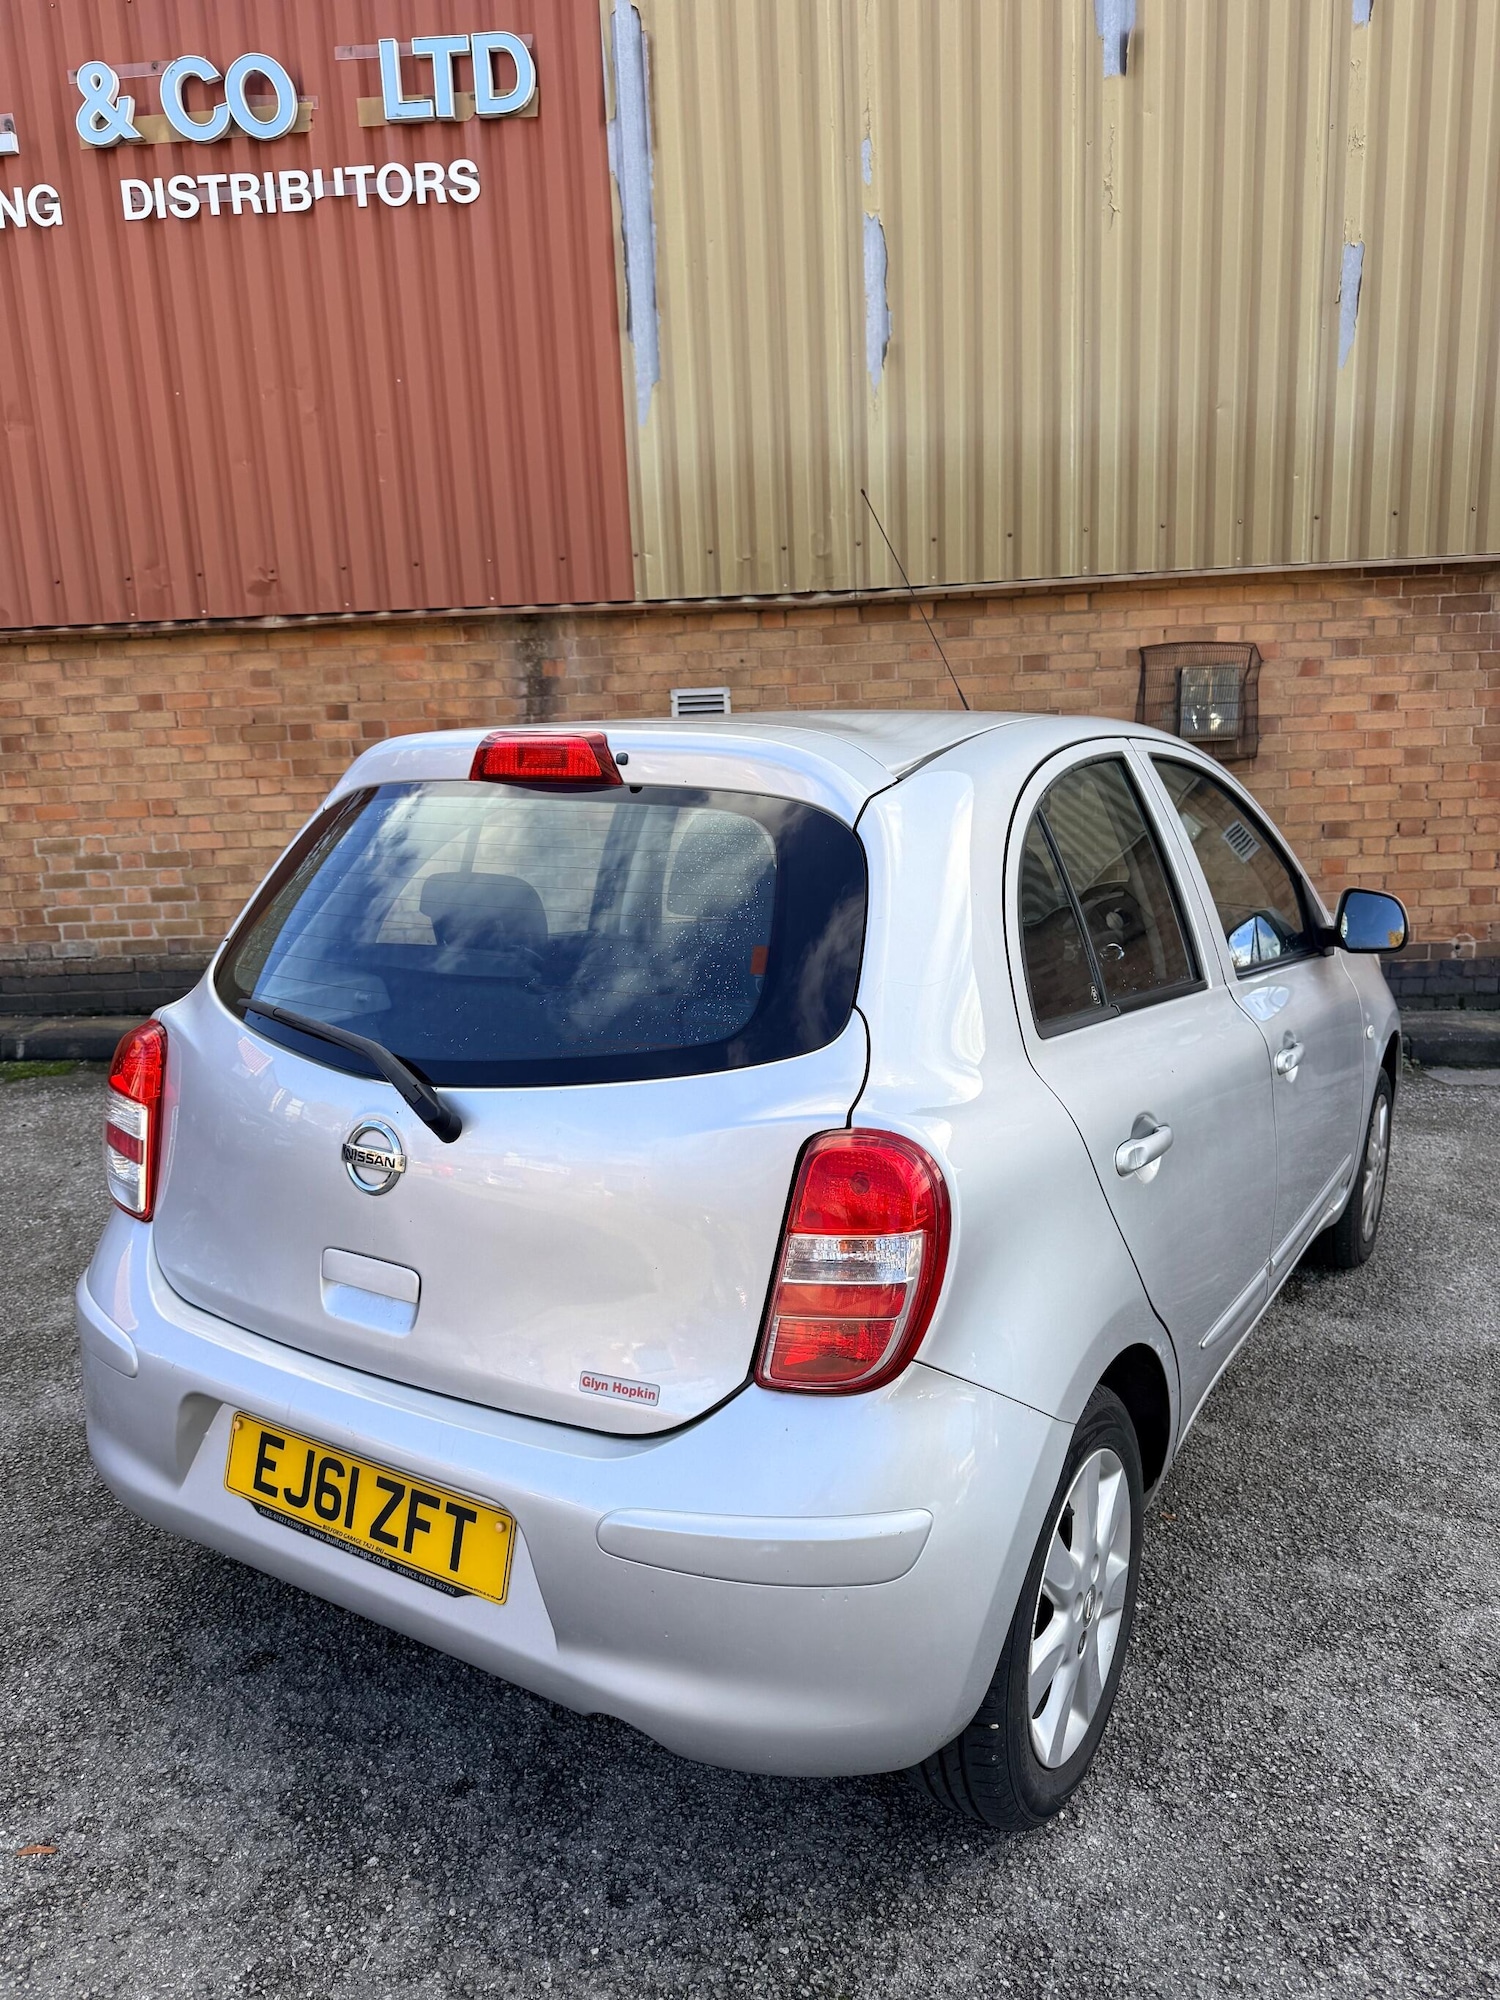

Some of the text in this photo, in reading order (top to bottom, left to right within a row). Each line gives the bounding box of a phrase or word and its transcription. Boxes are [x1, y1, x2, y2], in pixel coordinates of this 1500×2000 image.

[75, 60, 143, 146] &
[160, 52, 298, 145] CO
[378, 31, 536, 123] LTD
[343, 1145, 395, 1168] NISSAN
[582, 1376, 656, 1400] Glyn Hopkin
[253, 1431, 477, 1572] EJ61 ZFT
[309, 1527, 391, 1569] www.bulfordgarage.co.uk
[322, 1524, 343, 1537] BULFORD
[343, 1533, 362, 1546] GARAGE
